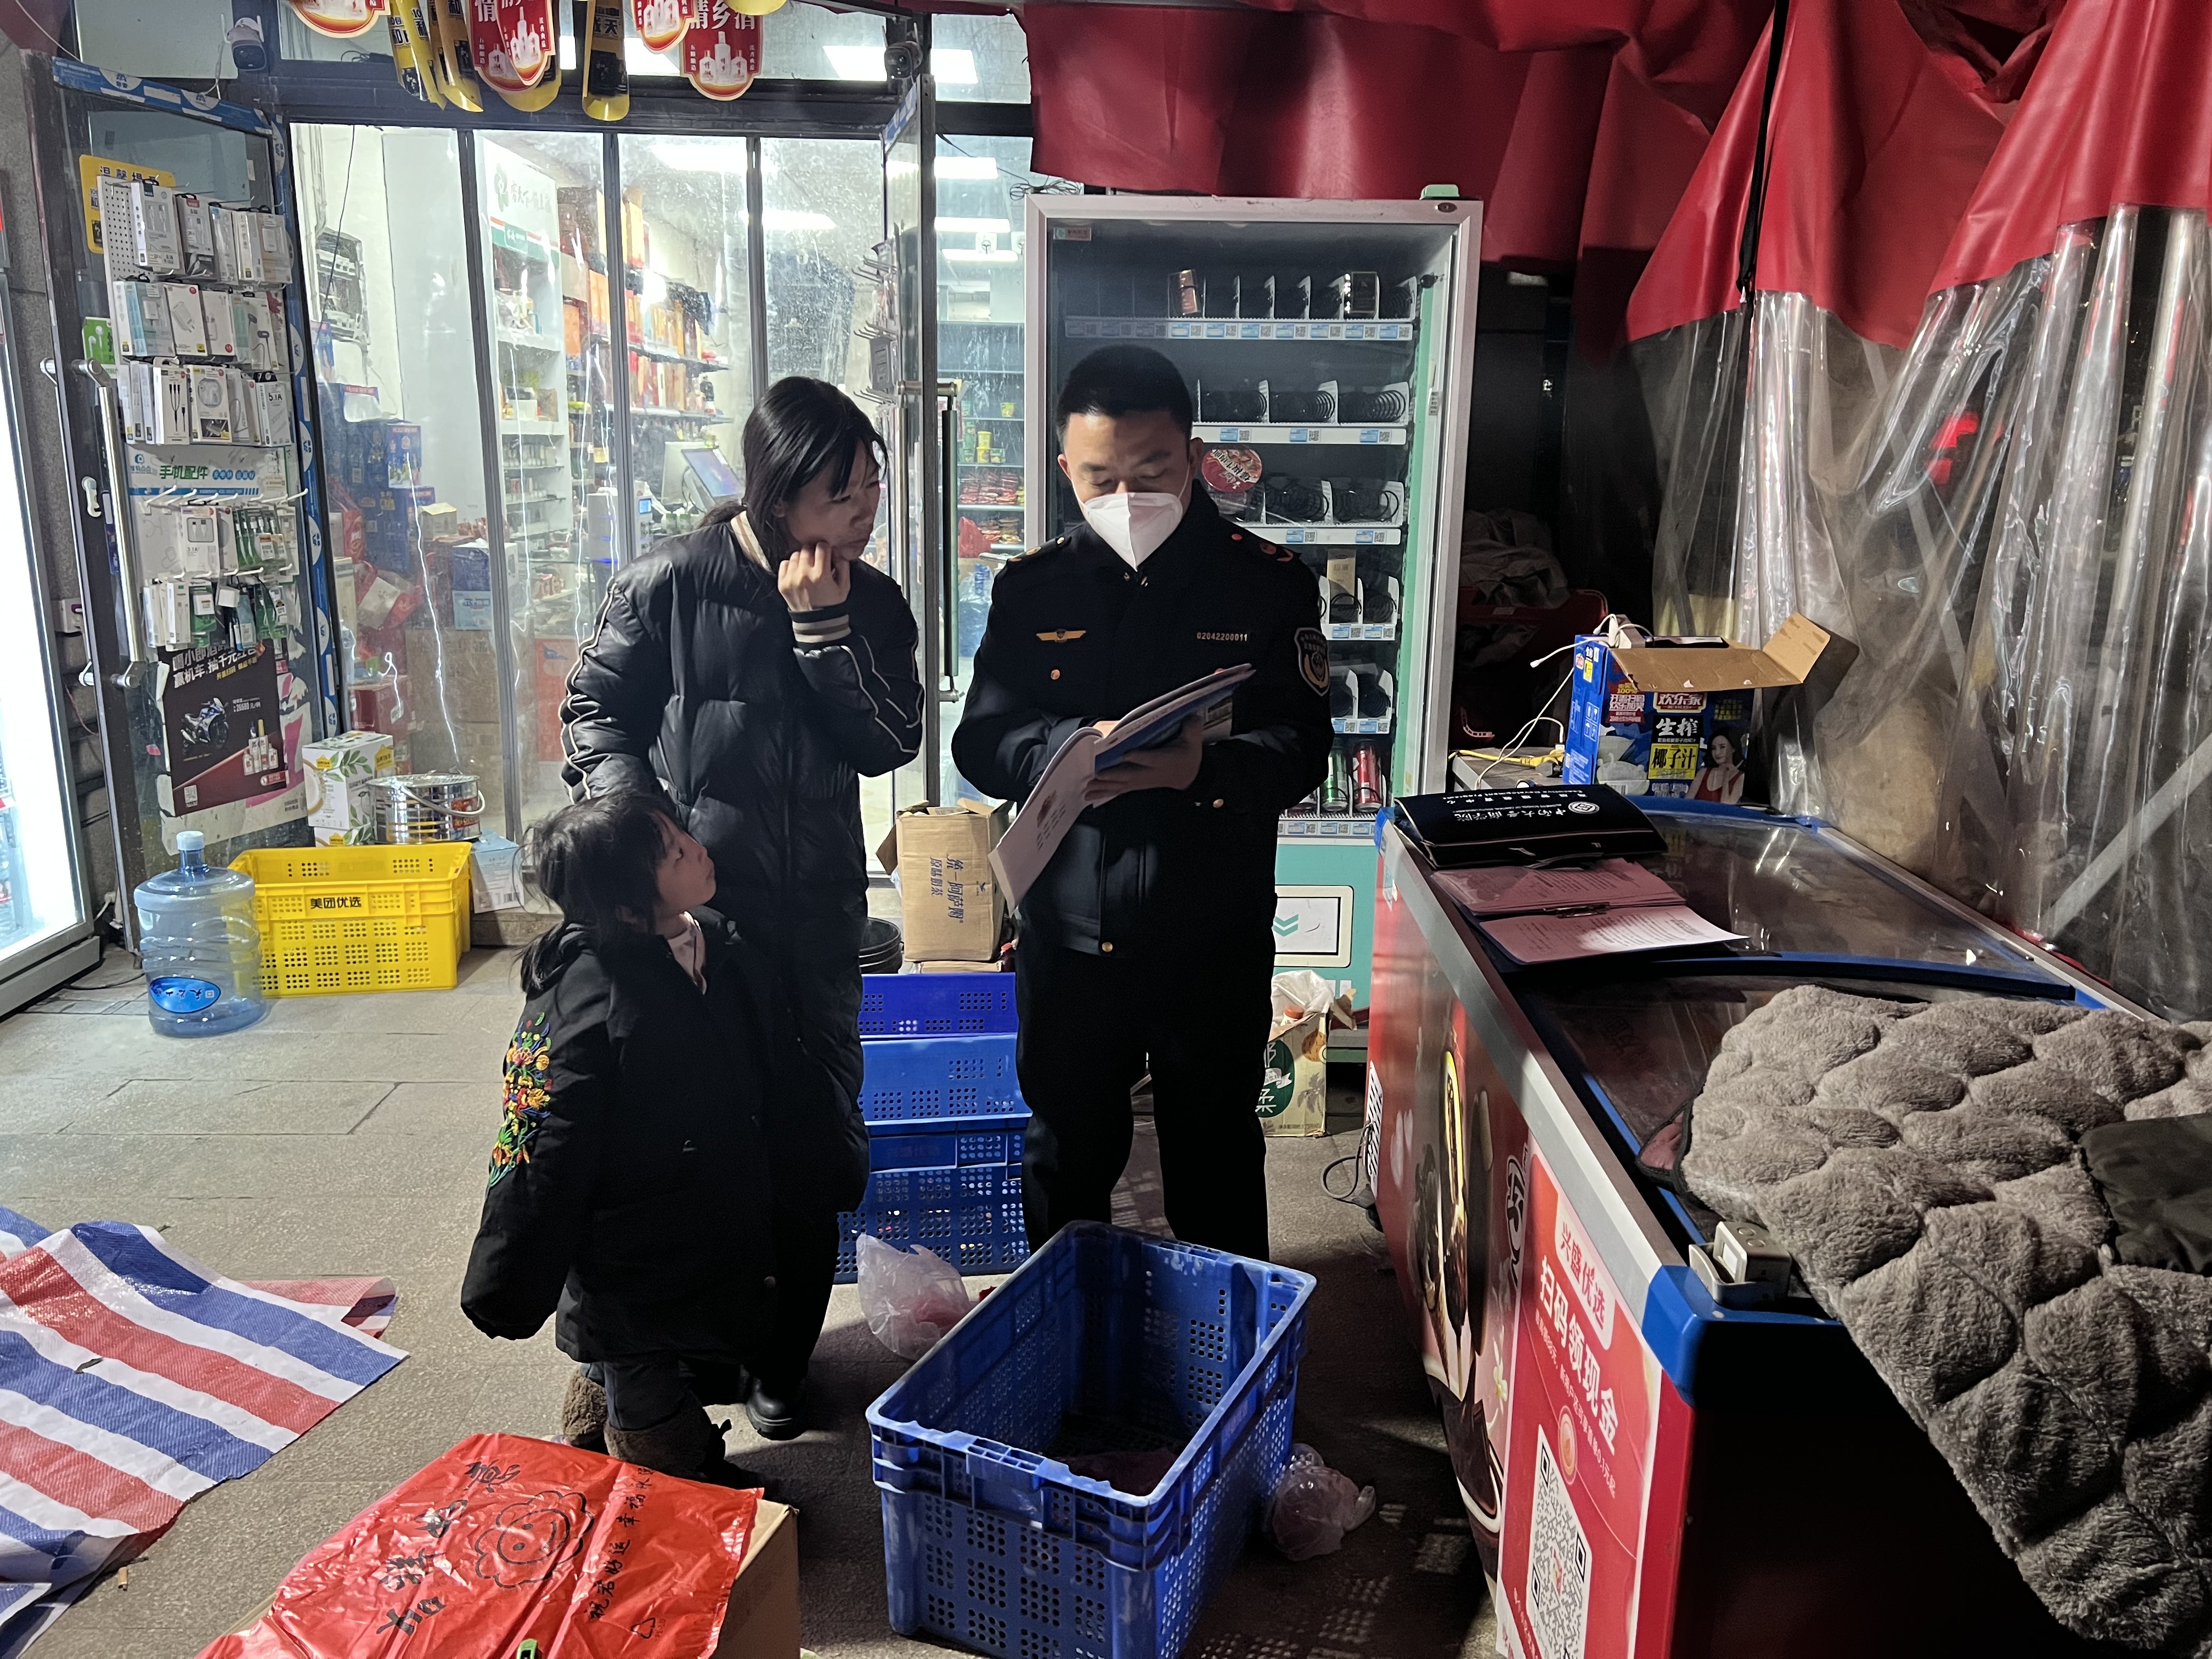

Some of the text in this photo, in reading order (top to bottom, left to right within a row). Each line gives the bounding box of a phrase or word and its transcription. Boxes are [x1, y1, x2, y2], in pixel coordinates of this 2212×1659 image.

[160, 465, 208, 479] 手机配件
[1197, 632, 1248, 642] 02042200011
[1658, 693, 1703, 706] 欢乐家
[1656, 718, 1699, 737] 生榨
[1652, 748, 1696, 769] 椰子汁
[930, 857, 943, 896] 原味奶茶
[947, 858, 964, 919] 统一阿萨姆
[310, 896, 362, 909] 美团优选
[1560, 1223, 1607, 1330] 兴盛优选
[1539, 1256, 1620, 1455] 扫码领现金
